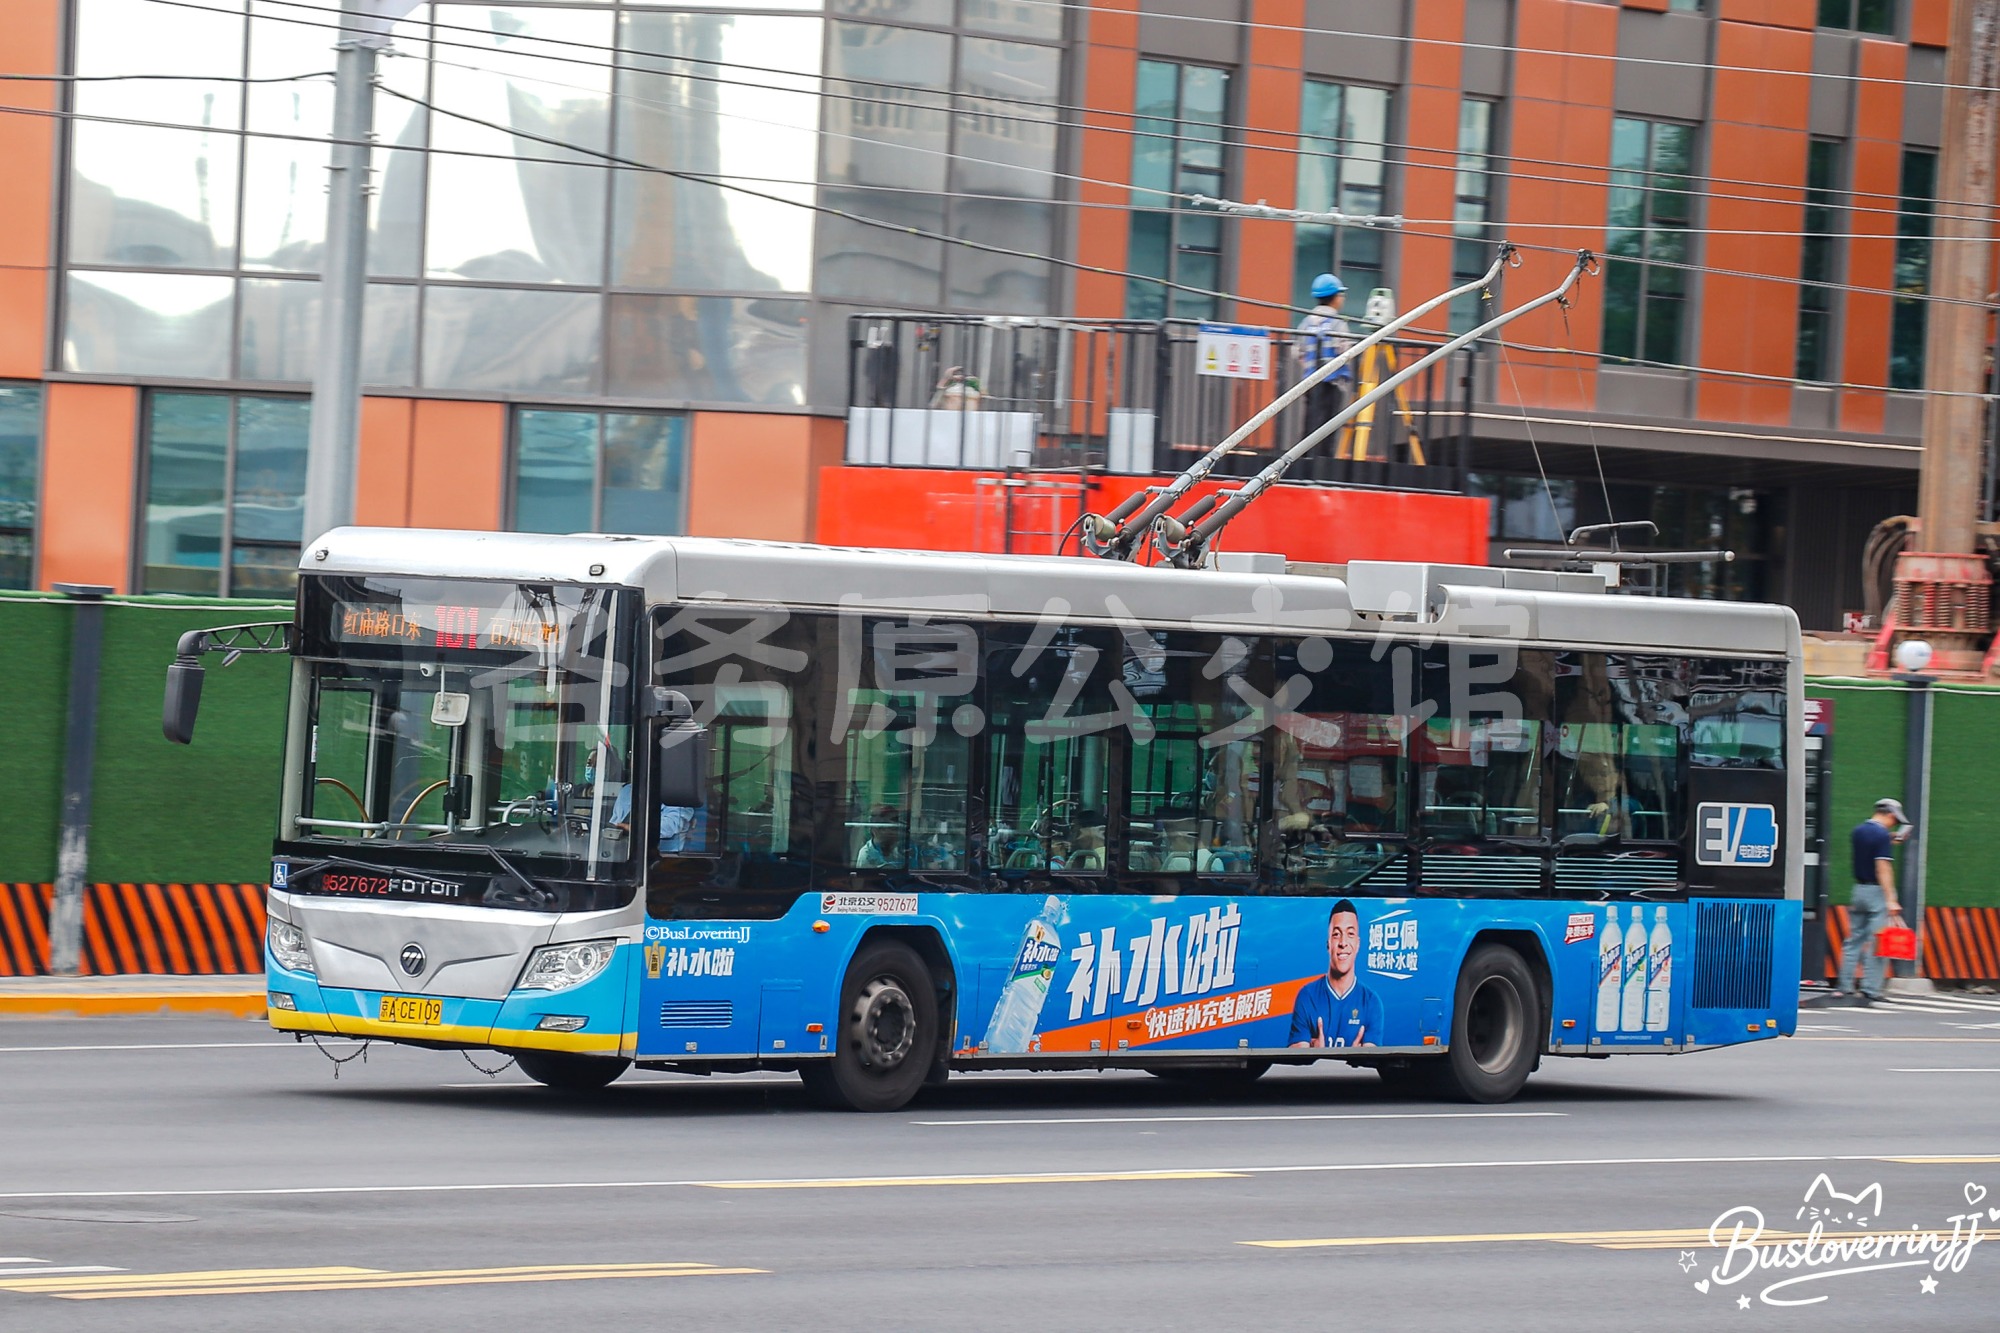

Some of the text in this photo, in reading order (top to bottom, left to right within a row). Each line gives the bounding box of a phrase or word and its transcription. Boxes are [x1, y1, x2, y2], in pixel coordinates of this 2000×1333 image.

[343, 607, 422, 640] 红庙路口东
[434, 604, 480, 649] 101
[322, 874, 388, 894] 9527672
[388, 878, 459, 897] FOTON
[839, 896, 876, 906] 北京公交
[877, 898, 917, 912] 9527672
[1368, 919, 1419, 951] 姆巴佩
[666, 947, 735, 977] 补水啦
[1066, 903, 1242, 1021] 补水啦
[1367, 951, 1418, 971] 喊你补水啦
[1147, 988, 1272, 1039] 快速补充电解质
